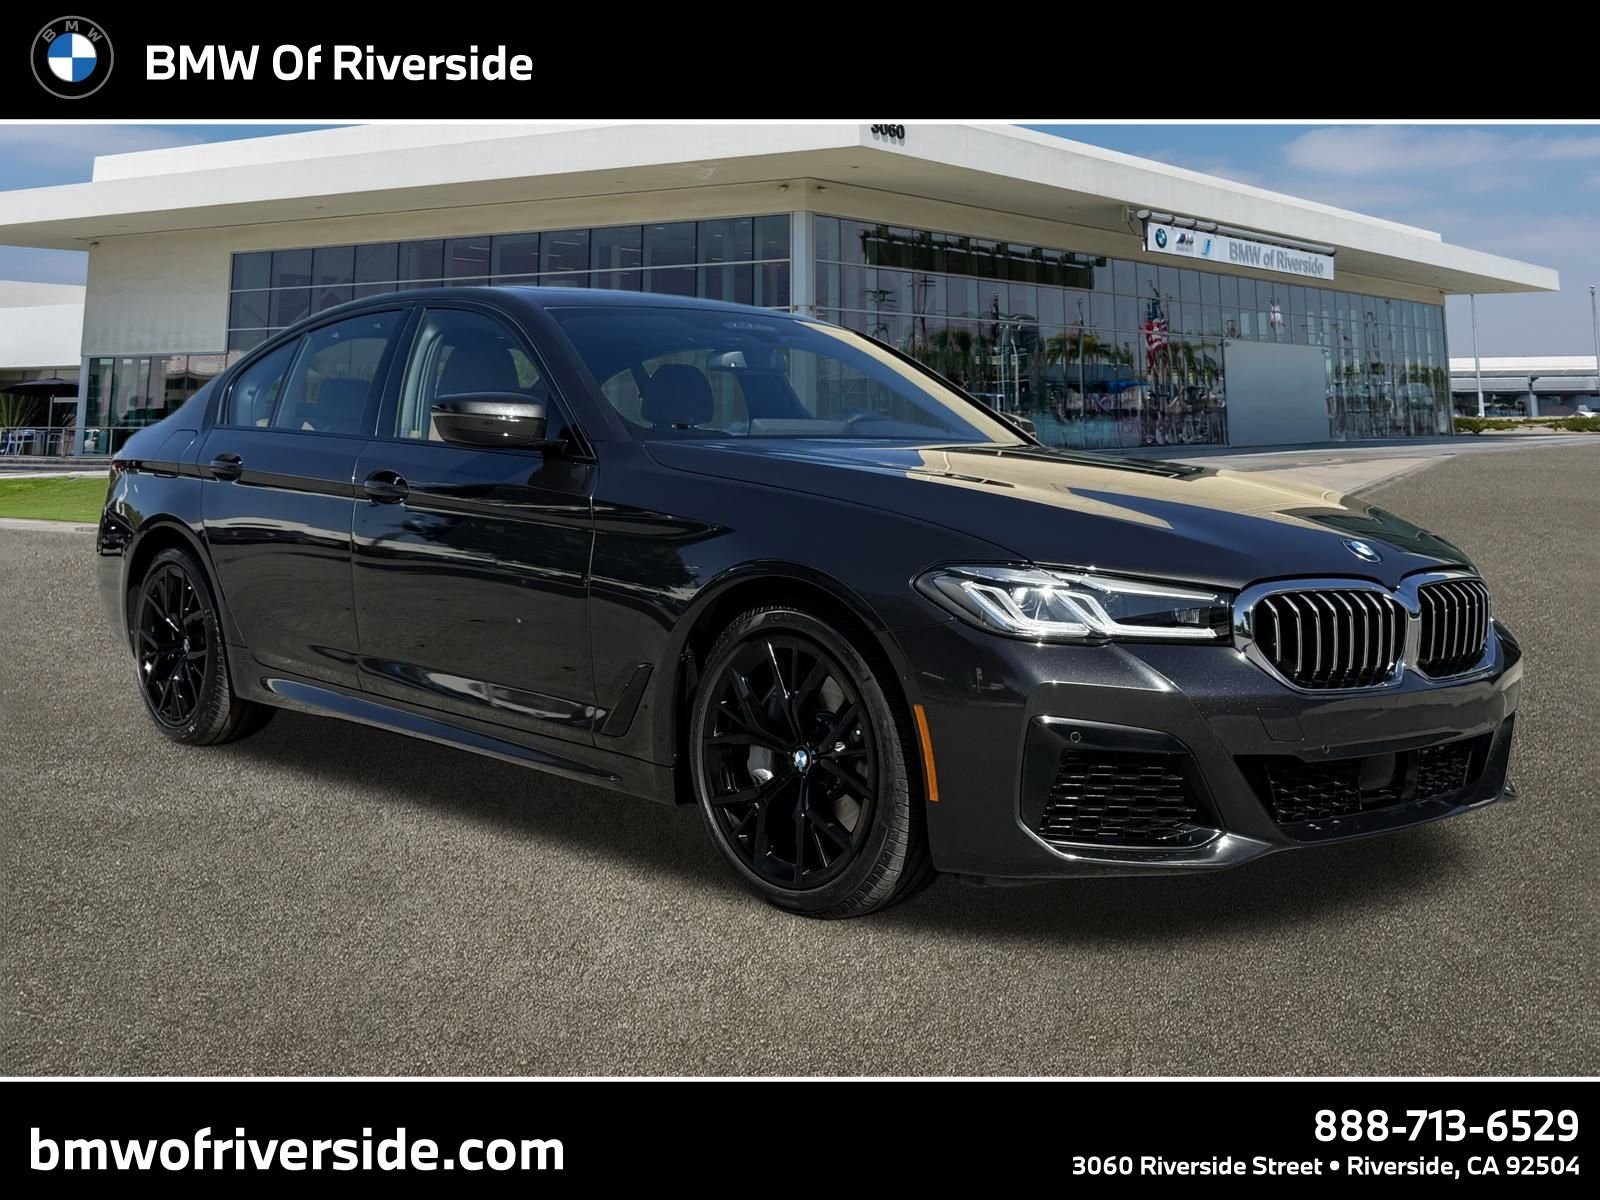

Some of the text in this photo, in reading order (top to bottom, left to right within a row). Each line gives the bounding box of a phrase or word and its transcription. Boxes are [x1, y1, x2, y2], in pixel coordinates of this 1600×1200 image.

[1229, 241, 1261, 265] BMW
[1263, 249, 1275, 267] of
[1276, 251, 1324, 274] Riverside
